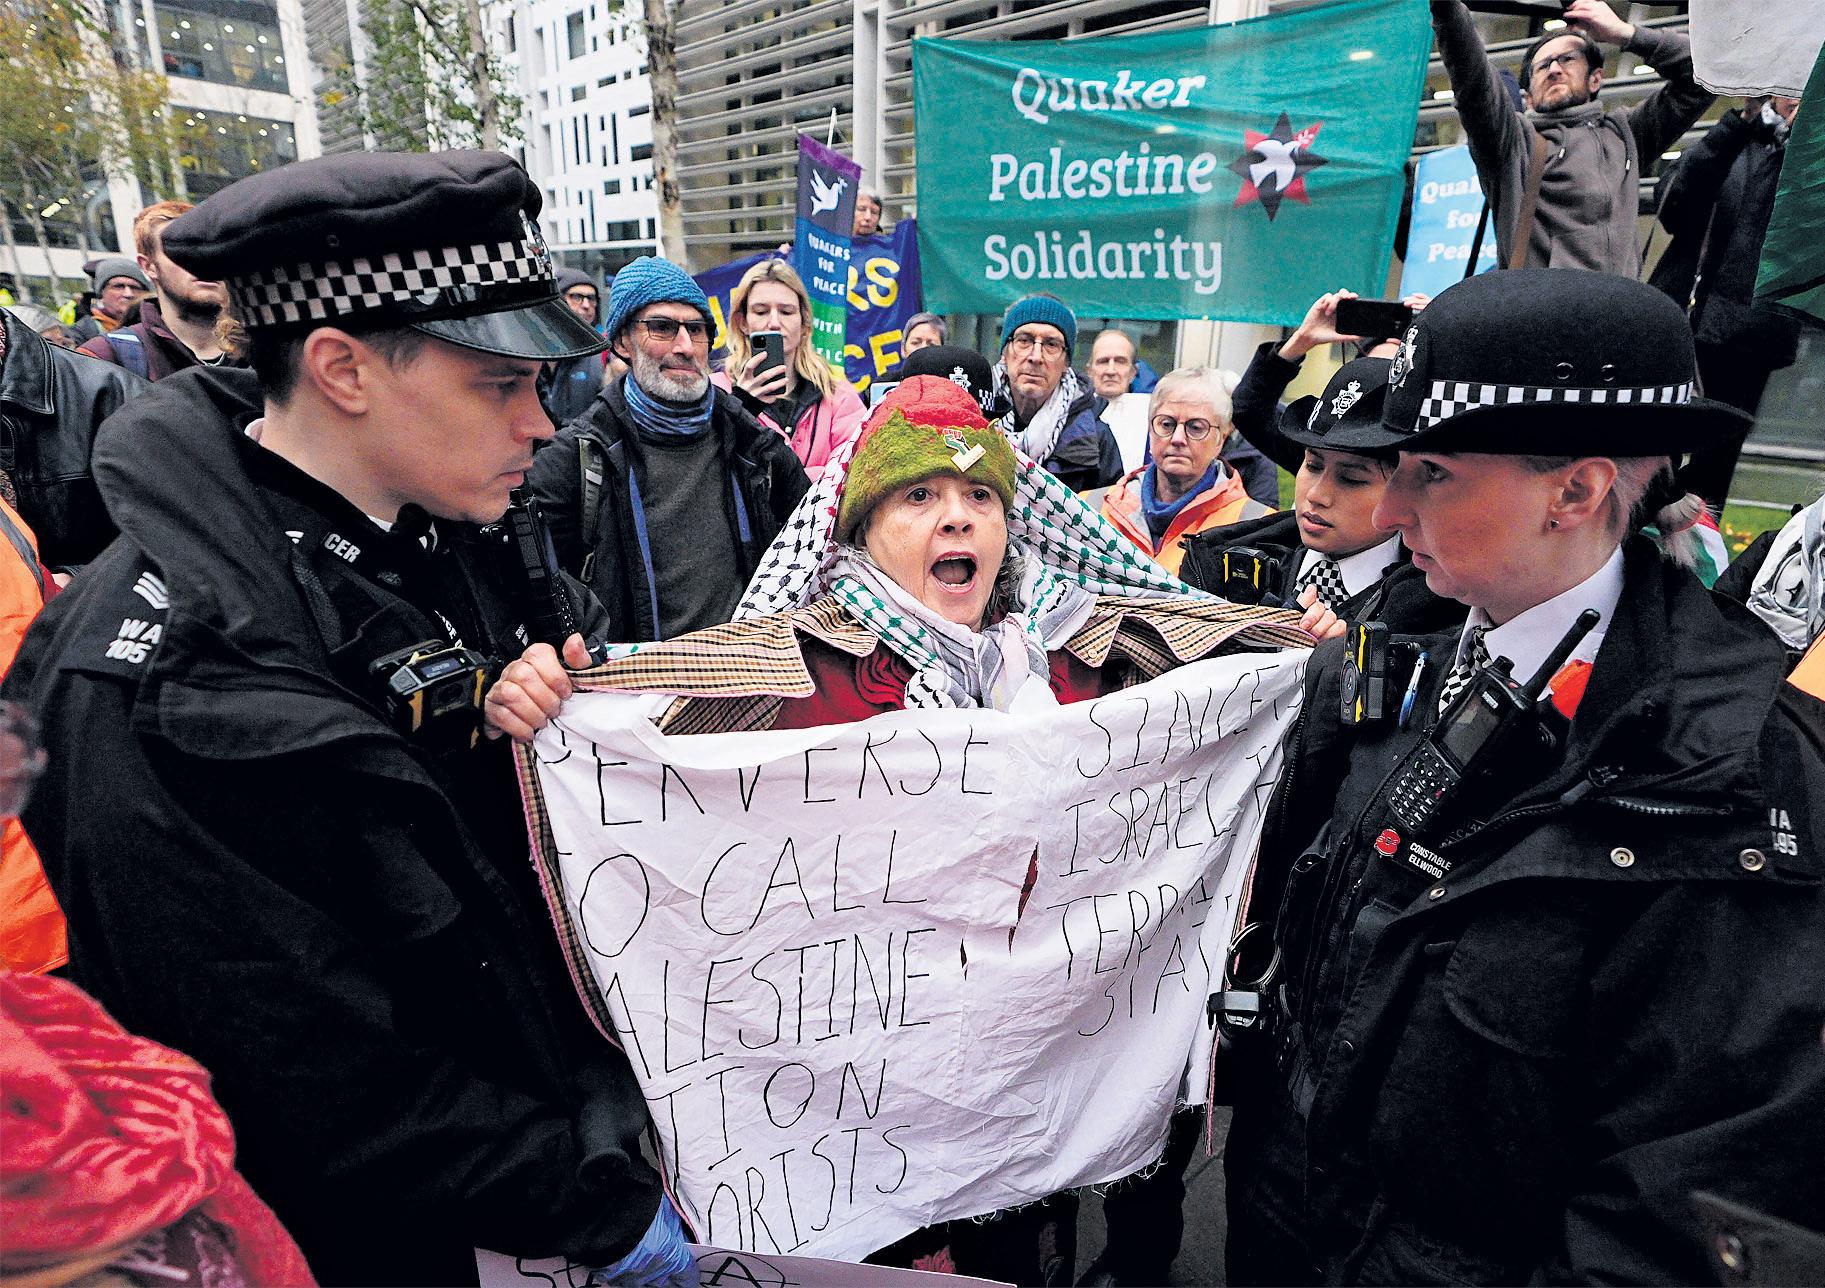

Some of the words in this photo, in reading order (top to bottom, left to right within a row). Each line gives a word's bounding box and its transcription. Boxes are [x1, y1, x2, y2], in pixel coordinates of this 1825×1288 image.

[1012, 68, 1206, 124] Quaker
[989, 142, 1217, 201] Palestine
[813, 276, 845, 296] PEACE
[984, 228, 1222, 295] Solidarity
[105, 639, 152, 664] 105
[118, 618, 163, 645] WA
[1060, 773, 1233, 877] ISRAEL
[701, 830, 928, 936] CALL
[1408, 853, 1443, 879] ELLWOOD
[1409, 842, 1452, 871] CONSTABLE
[605, 928, 937, 1080] ALESTINE
[644, 1059, 887, 1180] TION
